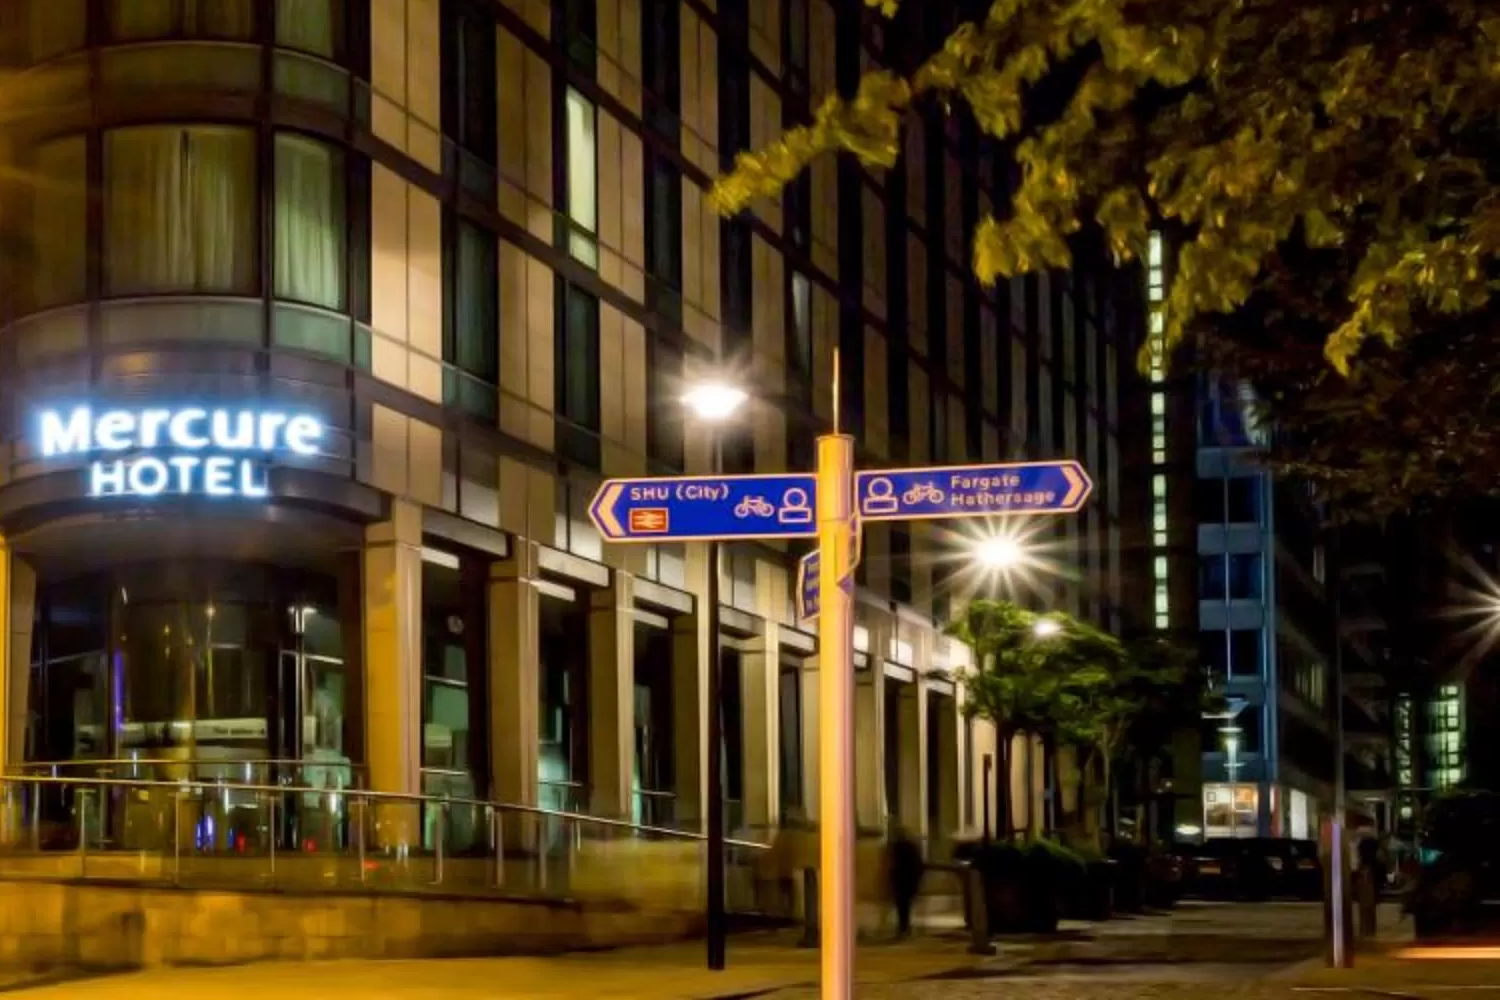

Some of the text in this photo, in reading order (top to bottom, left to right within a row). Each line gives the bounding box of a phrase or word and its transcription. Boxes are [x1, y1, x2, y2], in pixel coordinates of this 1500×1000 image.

[40, 404, 322, 455] Mercure
[90, 455, 268, 498] HOTEL
[950, 474, 1020, 490] Fargate
[630, 483, 729, 502] SHU (City)
